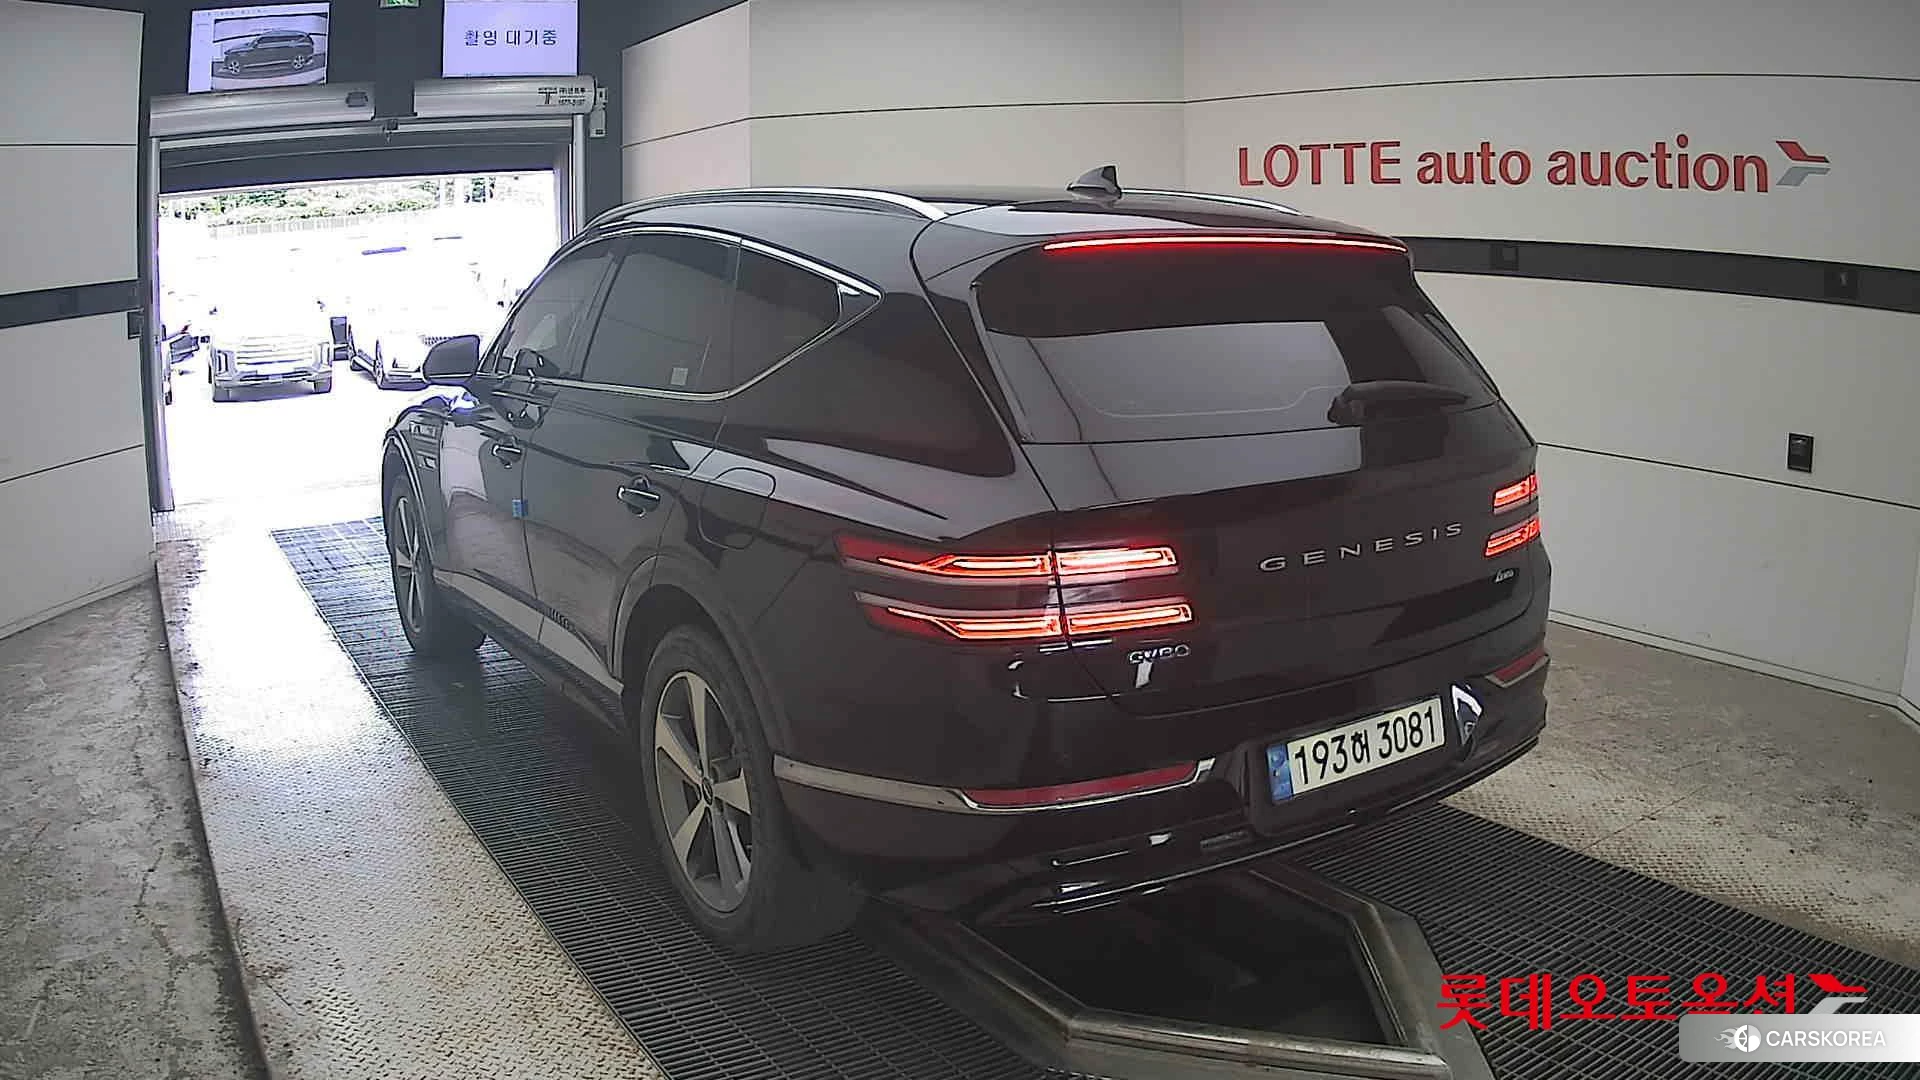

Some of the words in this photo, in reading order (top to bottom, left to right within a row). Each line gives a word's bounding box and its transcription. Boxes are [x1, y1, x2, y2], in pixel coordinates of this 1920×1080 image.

[506, 29, 557, 46] 대기중
[1238, 141, 1401, 188] LOTTE
[1416, 141, 1532, 186] auto
[1547, 133, 1769, 193] auction
[1259, 523, 1463, 572] GENESIS
[1294, 728, 1371, 786] 193허
[1377, 705, 1436, 760] 3081
